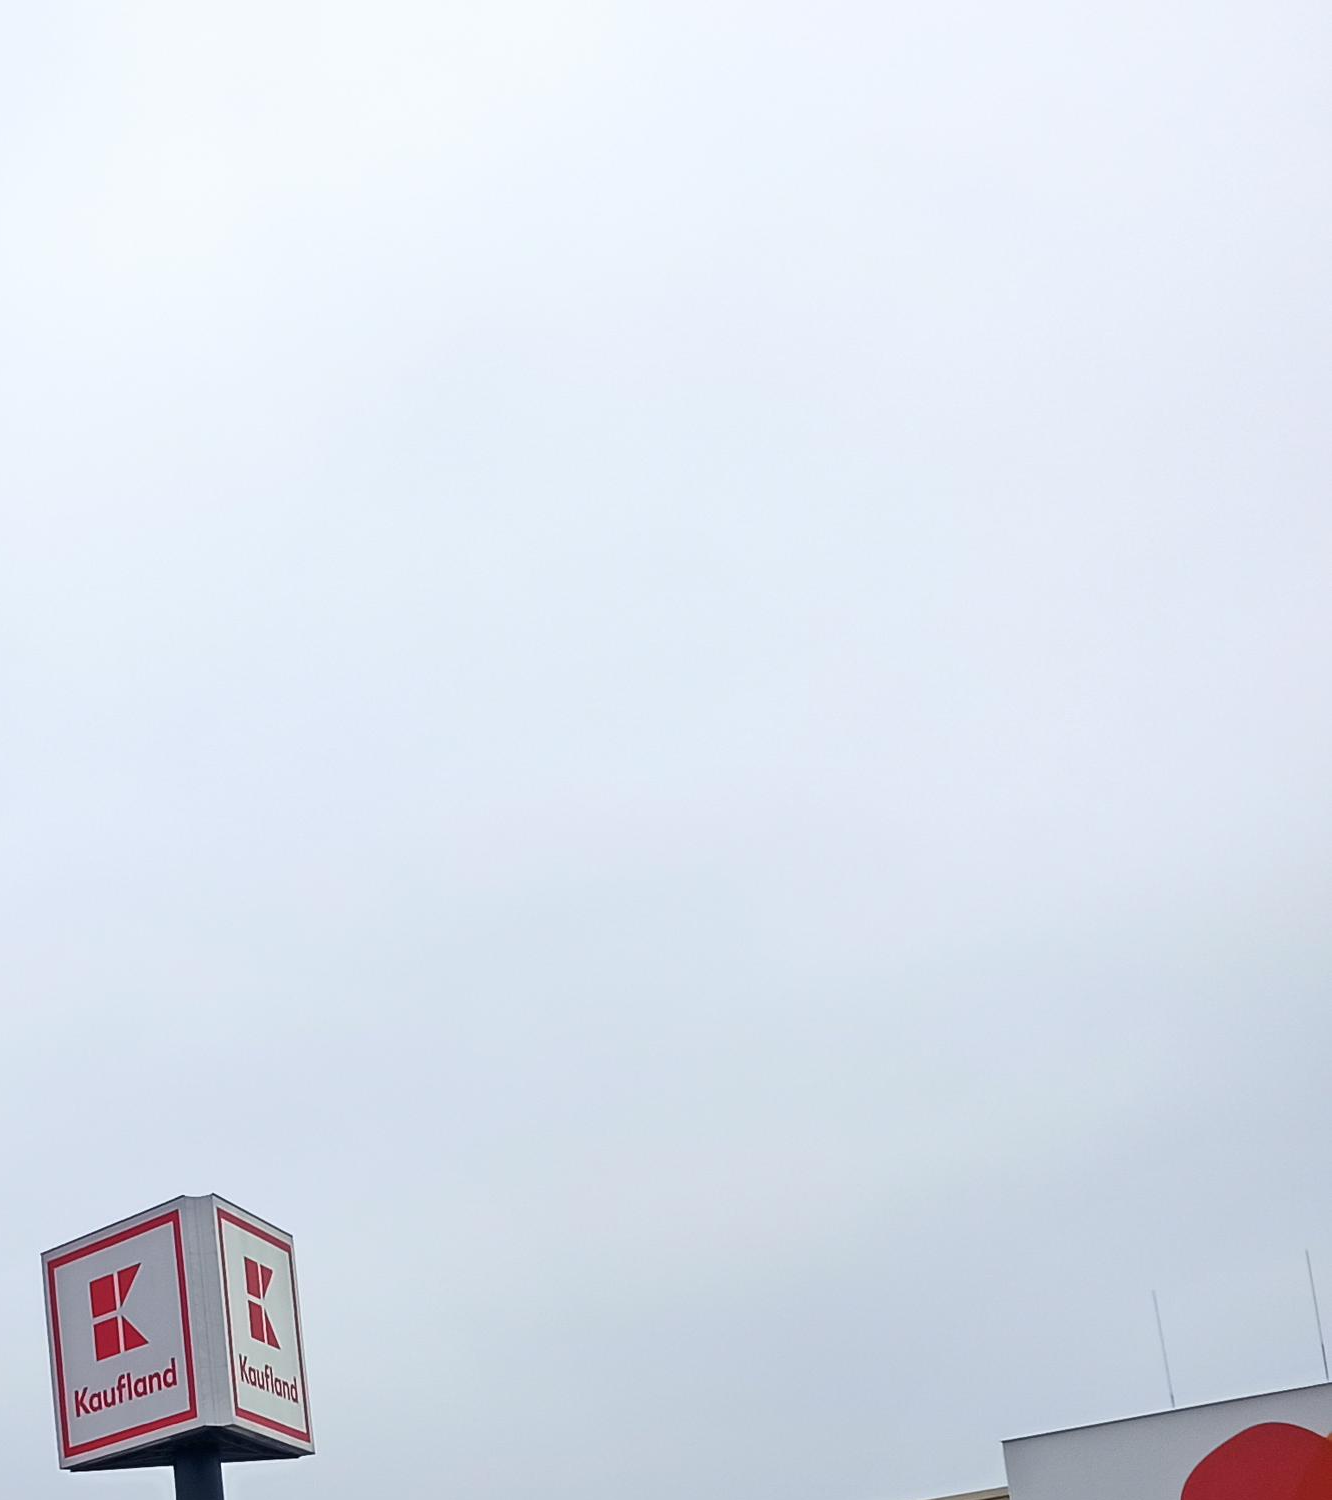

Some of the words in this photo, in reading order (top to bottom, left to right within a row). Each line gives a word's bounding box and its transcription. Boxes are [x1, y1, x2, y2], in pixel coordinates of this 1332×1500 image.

[89, 1262, 150, 1362] K
[74, 1357, 178, 1418] Kaufland
[239, 1353, 299, 1404] Kaufland
